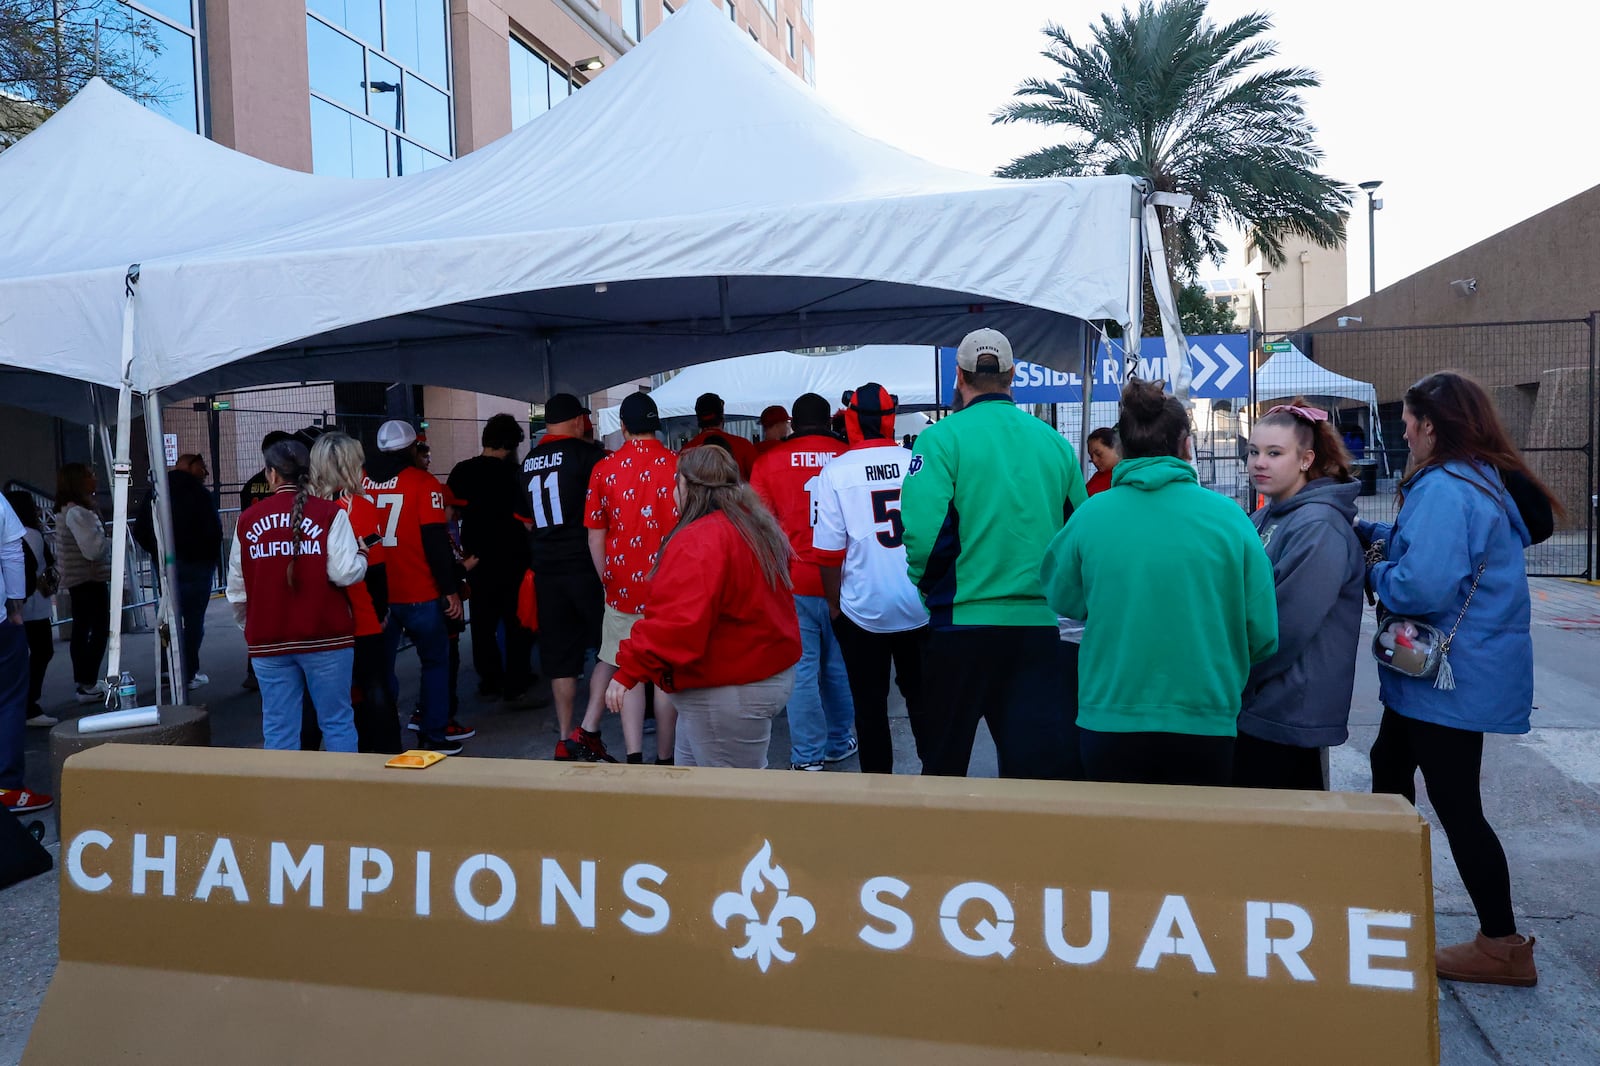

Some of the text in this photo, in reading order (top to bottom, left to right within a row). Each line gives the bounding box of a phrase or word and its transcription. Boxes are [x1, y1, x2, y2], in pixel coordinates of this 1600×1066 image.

[865, 463, 900, 481] RINGO
[363, 494, 404, 546] 7
[528, 471, 563, 528] 11
[871, 488, 905, 548] 5
[246, 513, 323, 543] SOUTHRN
[67, 829, 1415, 990] CHAMPIONS SQUARE
